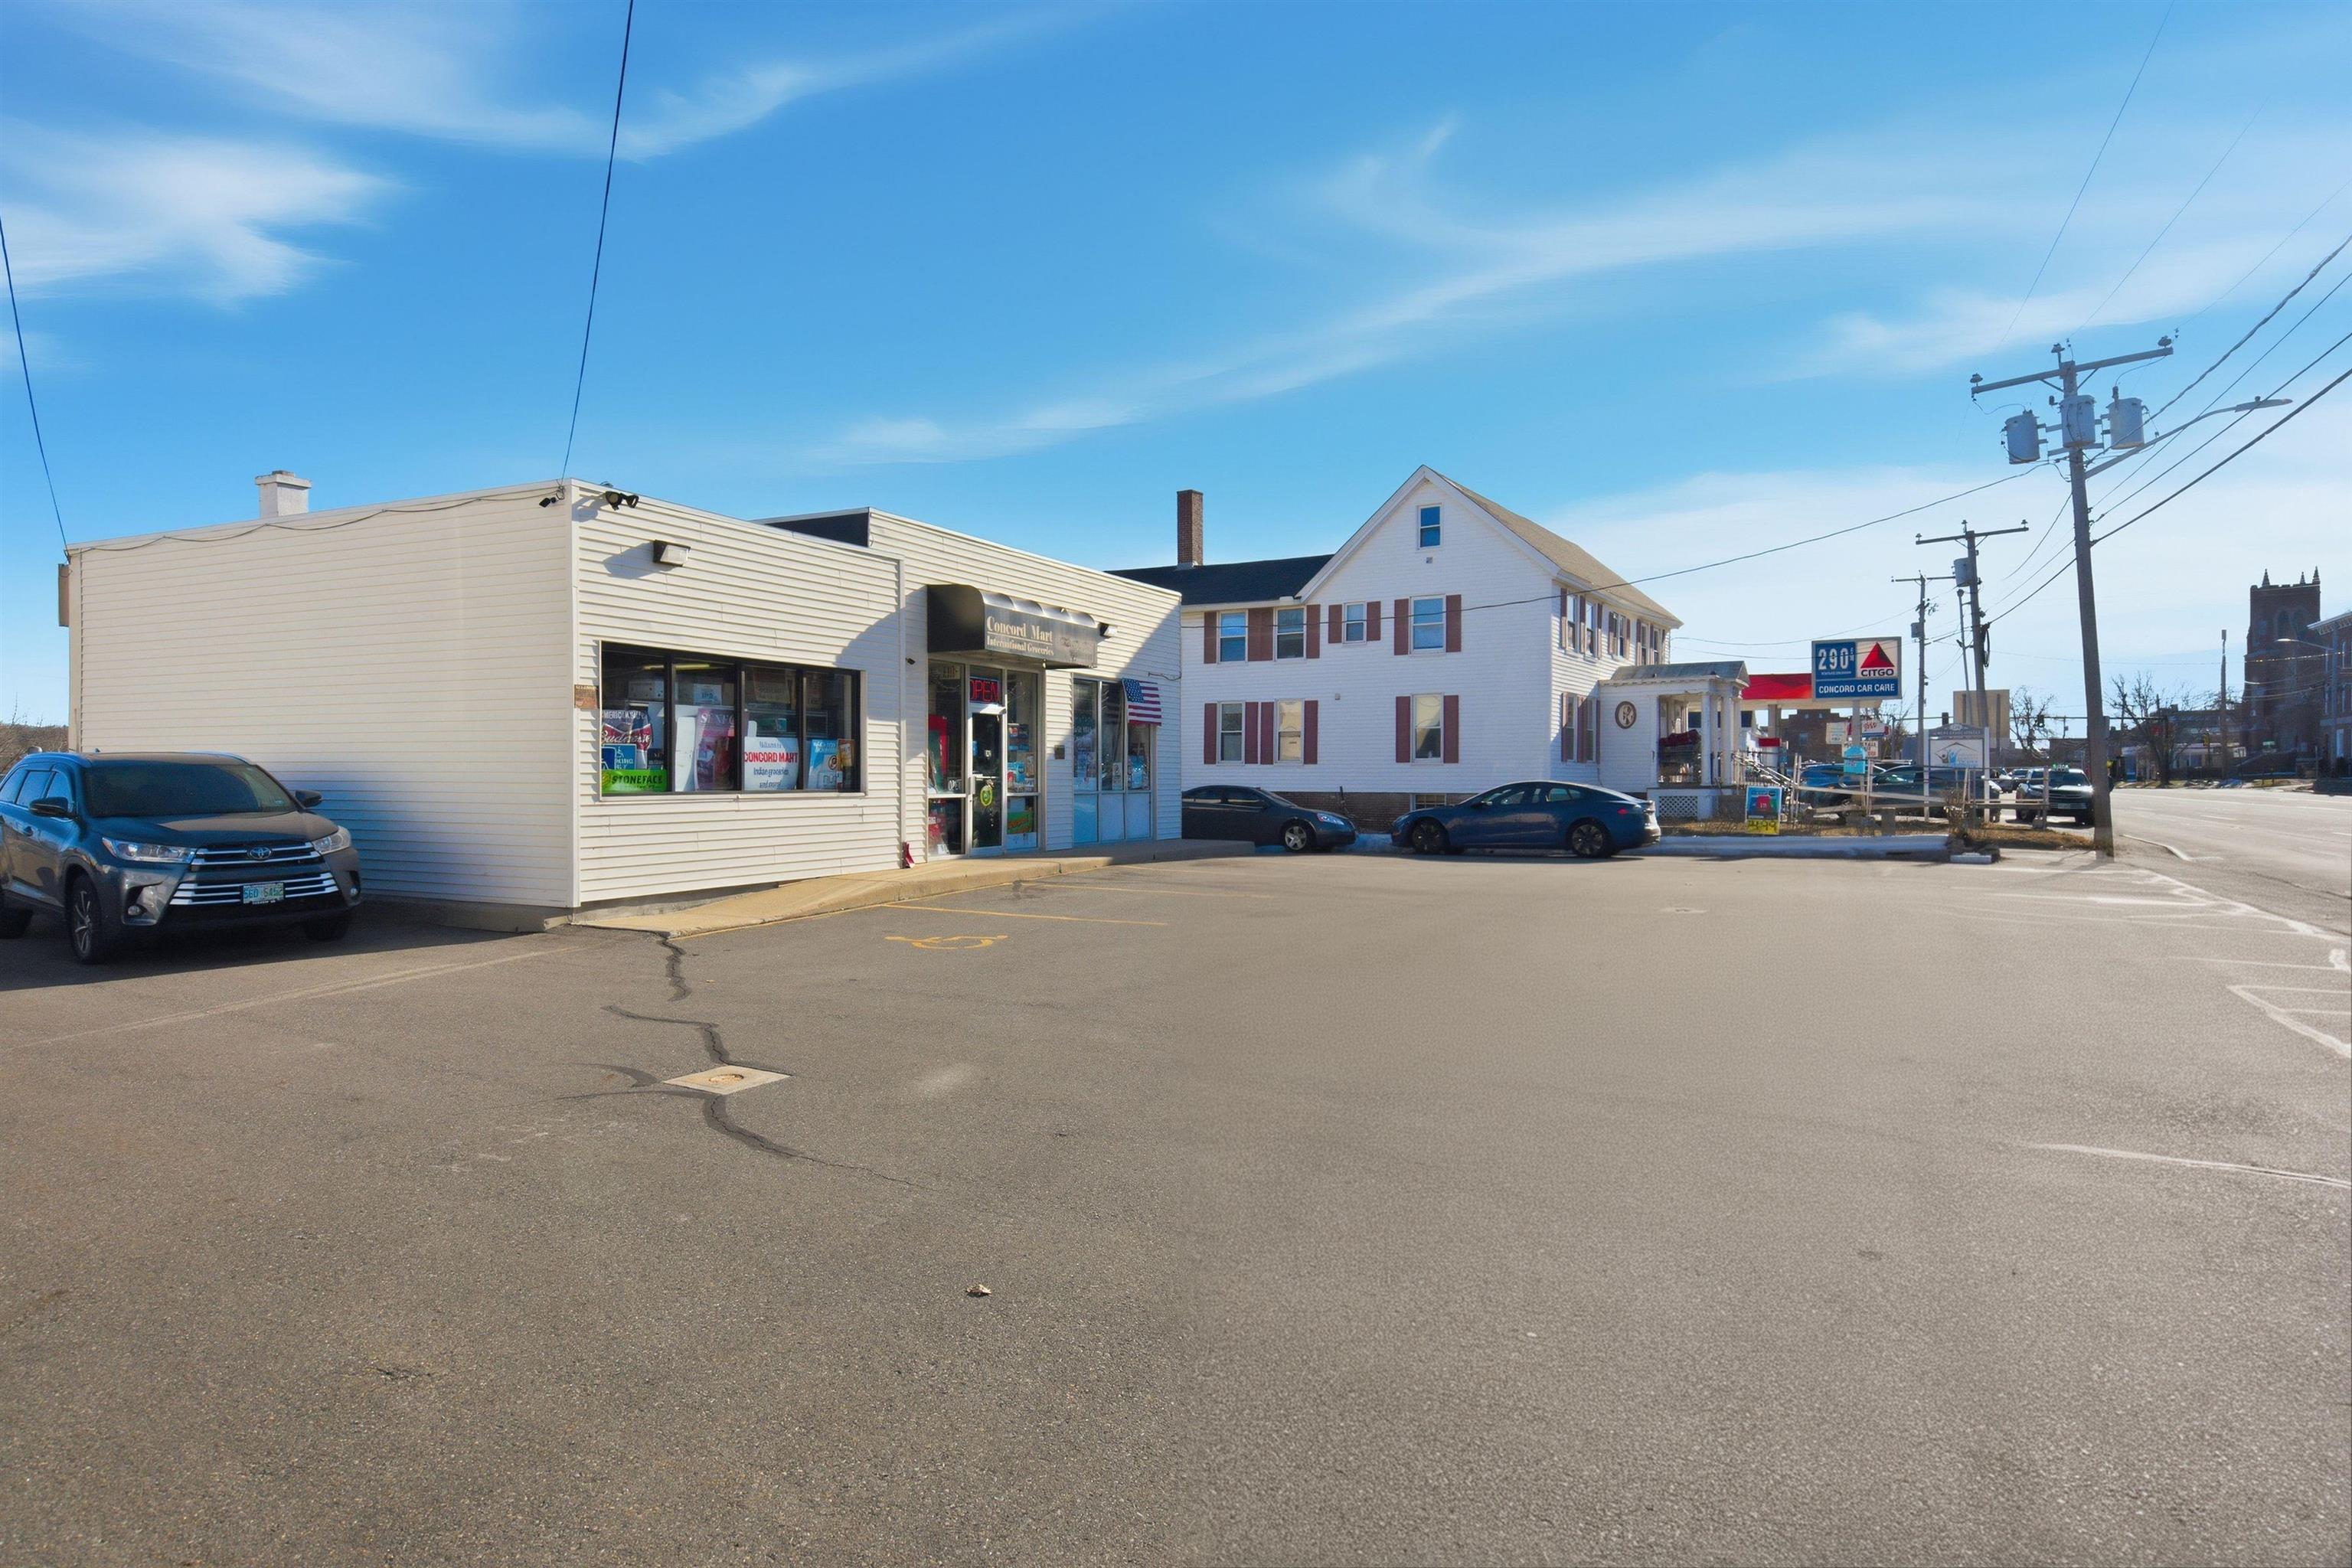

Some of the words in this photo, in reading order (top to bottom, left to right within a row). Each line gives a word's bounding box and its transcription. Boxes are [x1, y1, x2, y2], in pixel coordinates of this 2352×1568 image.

[987, 616, 1026, 637] Concord
[1031, 625, 1054, 642] Mart
[987, 635, 1026, 651] International
[1027, 642, 1054, 656] Groceries
[1818, 648, 1848, 670] 290
[1860, 668, 1894, 677] CITGO
[1818, 684, 1855, 694] CONCORD
[1857, 684, 1873, 693] CAR
[1873, 683, 1895, 691] CARE
[744, 752, 777, 763] CONCORD
[779, 752, 799, 763] MART
[611, 775, 663, 784] STONEFACE
